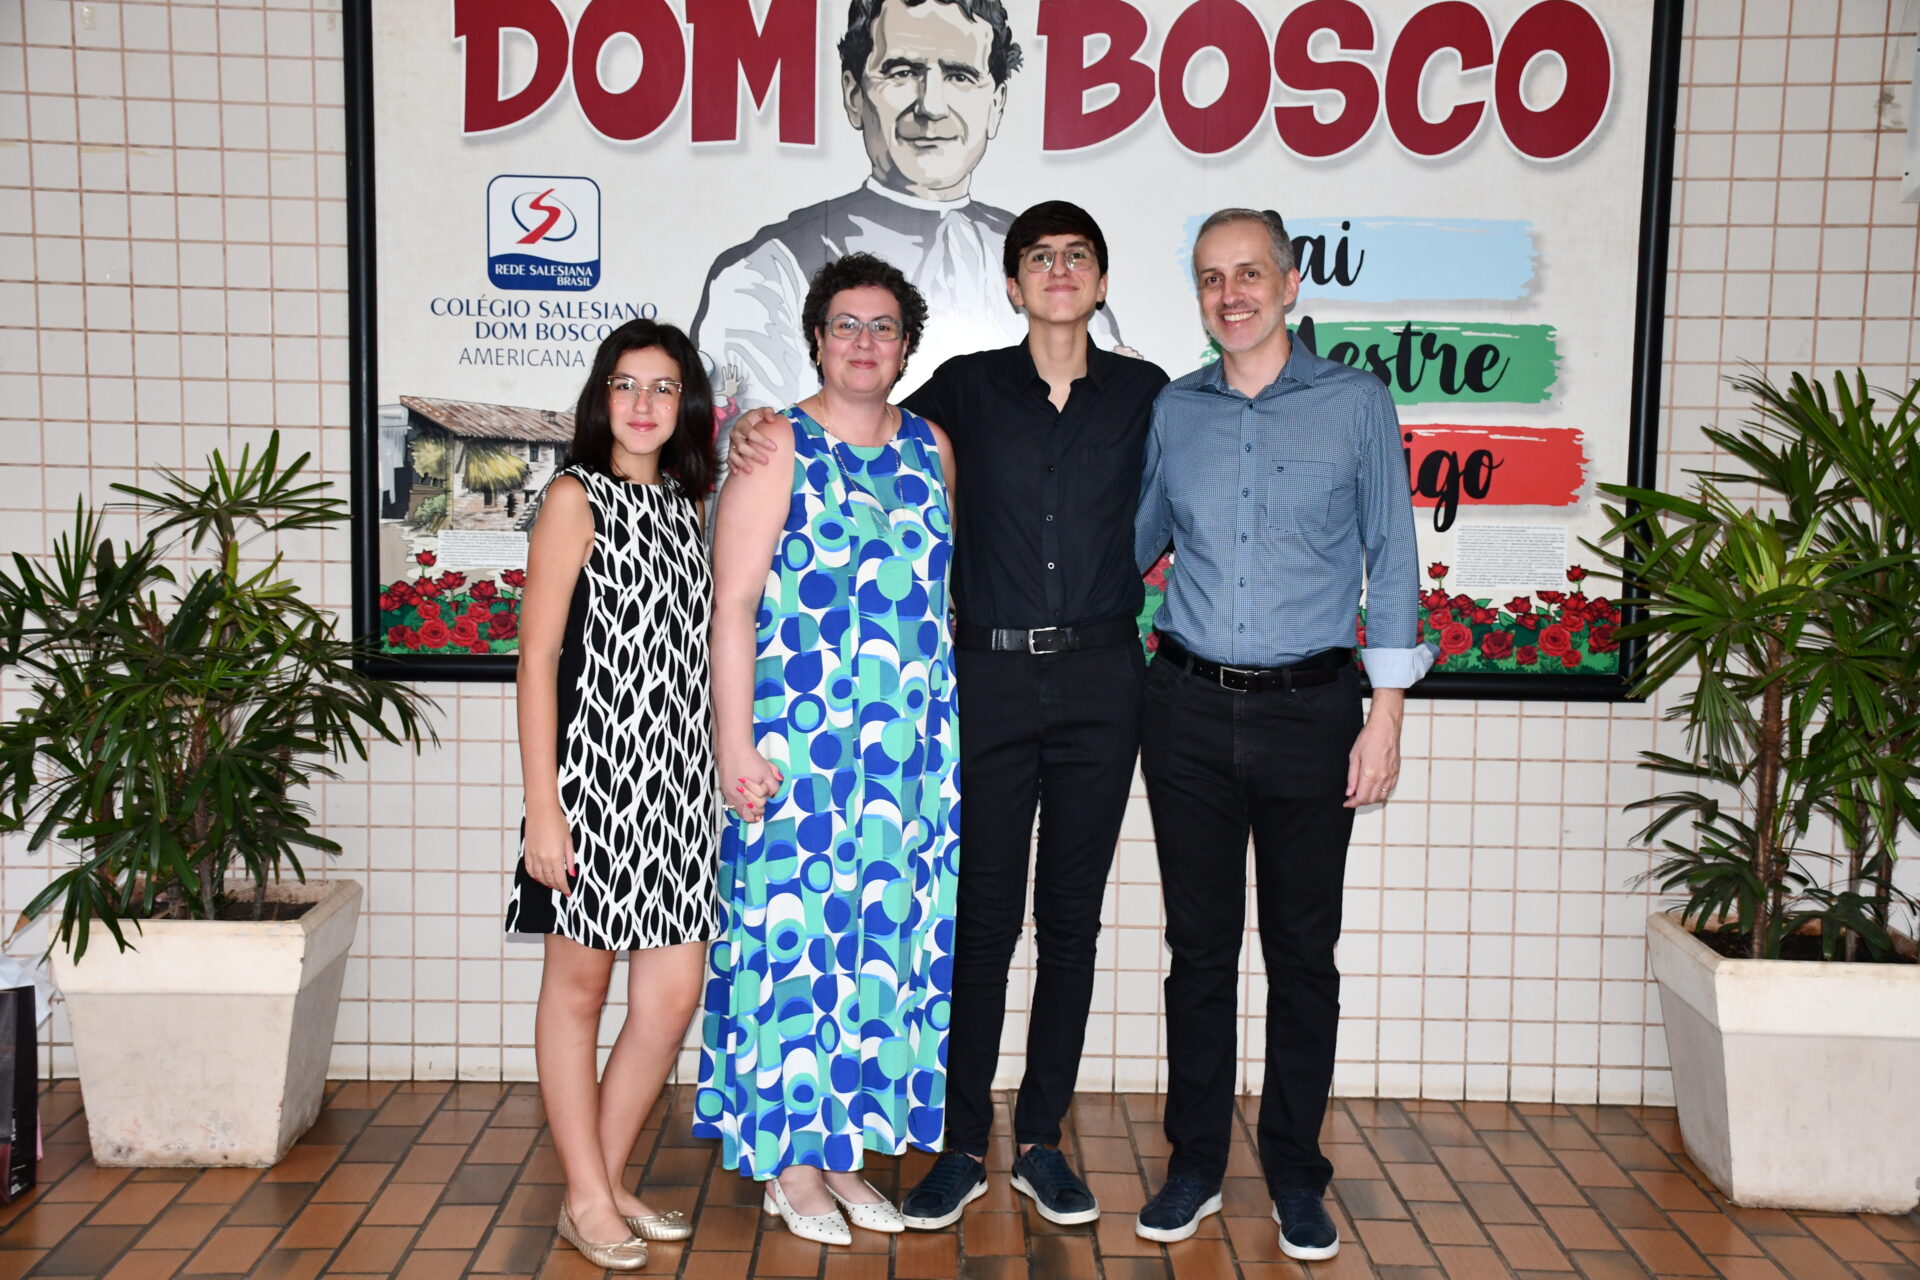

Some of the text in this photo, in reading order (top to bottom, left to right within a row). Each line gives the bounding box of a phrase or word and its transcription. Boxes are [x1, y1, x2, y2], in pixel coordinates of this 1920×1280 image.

[453, 0, 1612, 160] DOM BOSCO
[1264, 210, 1365, 287] ai
[495, 263, 593, 277] REDE SALESIANA
[556, 276, 592, 287] BRASIL
[430, 293, 658, 320] COLÉGIO SALESIANO
[475, 321, 613, 342] DOM BOSCO
[458, 348, 586, 367] AMERICANA
